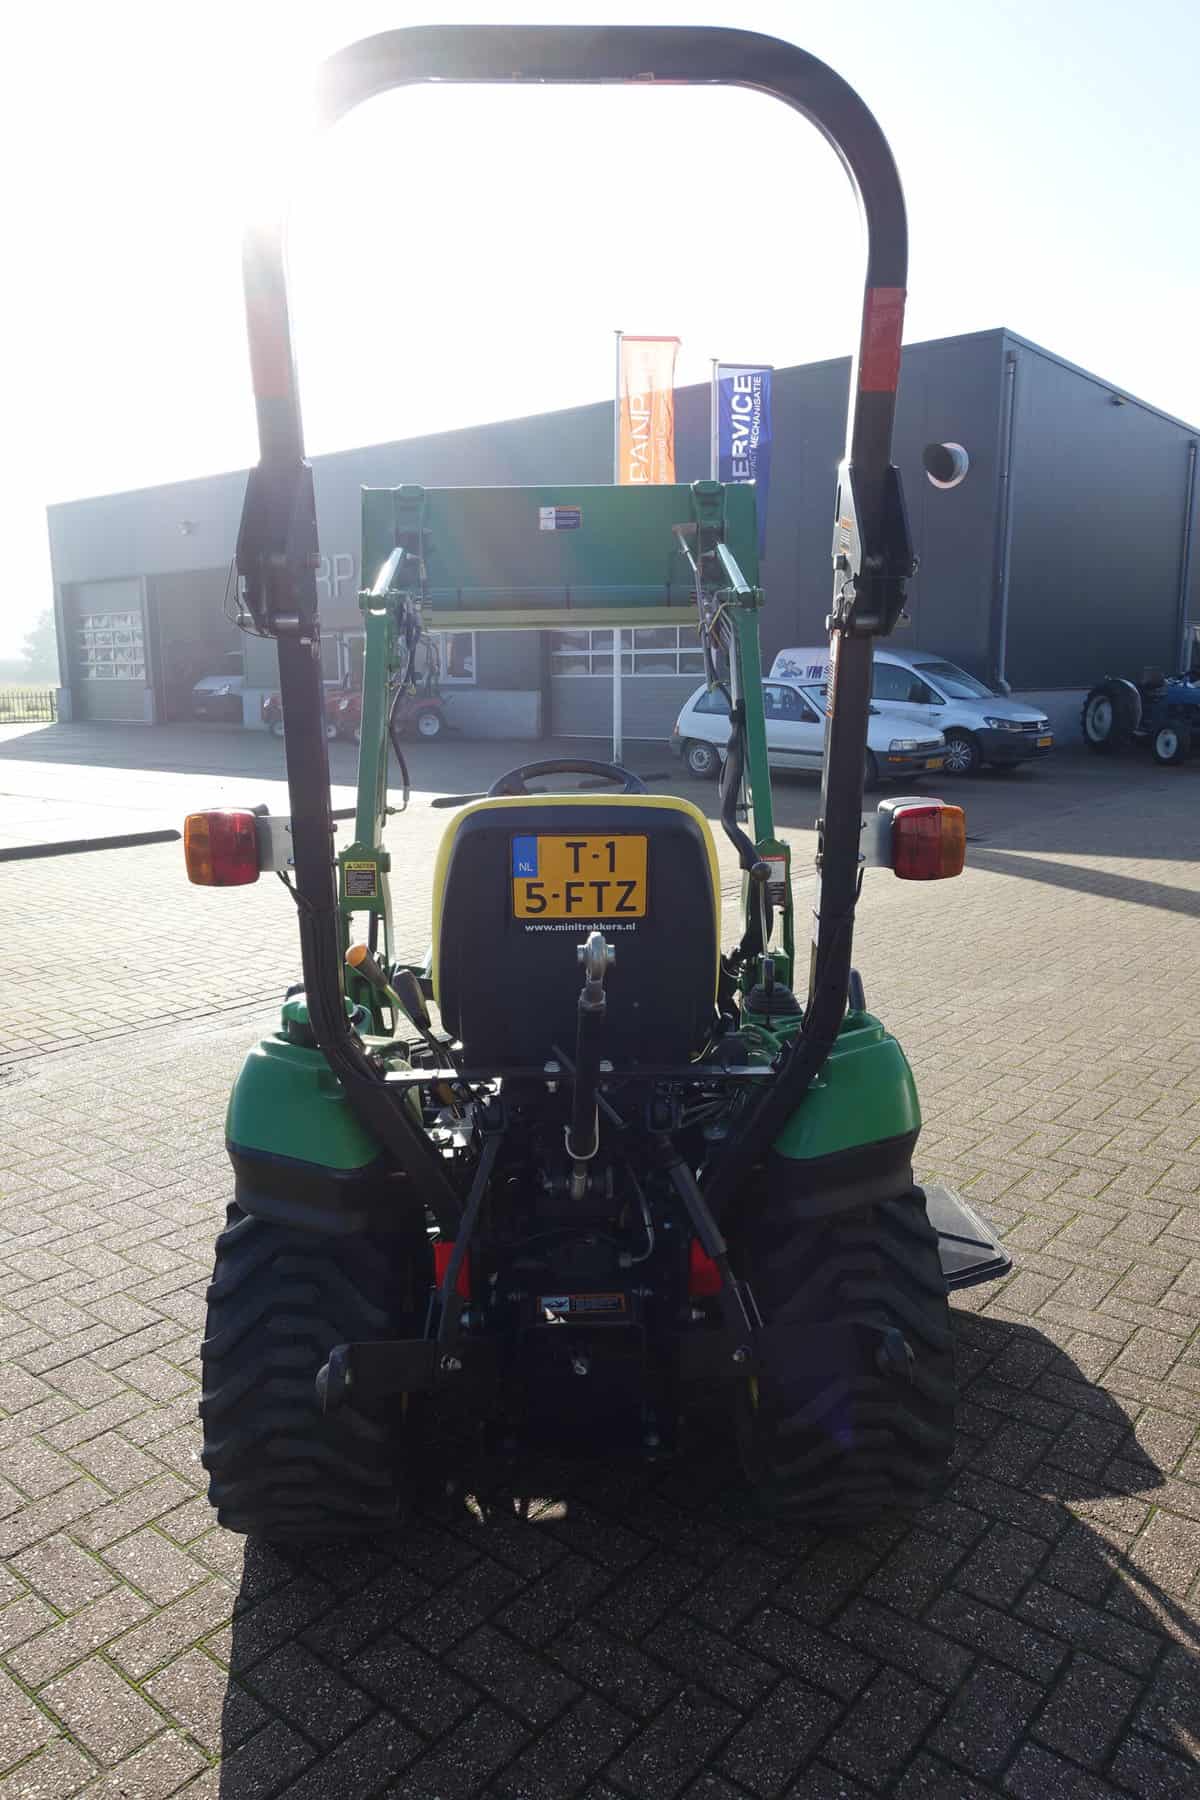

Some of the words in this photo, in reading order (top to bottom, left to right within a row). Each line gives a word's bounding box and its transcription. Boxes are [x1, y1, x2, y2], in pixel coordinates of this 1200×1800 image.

[750, 375, 762, 449] MECHANISATIE
[731, 375, 754, 483] ERVICE
[519, 862, 534, 872] NL
[565, 841, 616, 873] T-1
[525, 881, 637, 914] 5-FTZ
[524, 922, 636, 932] www.minitrekkers.nl
